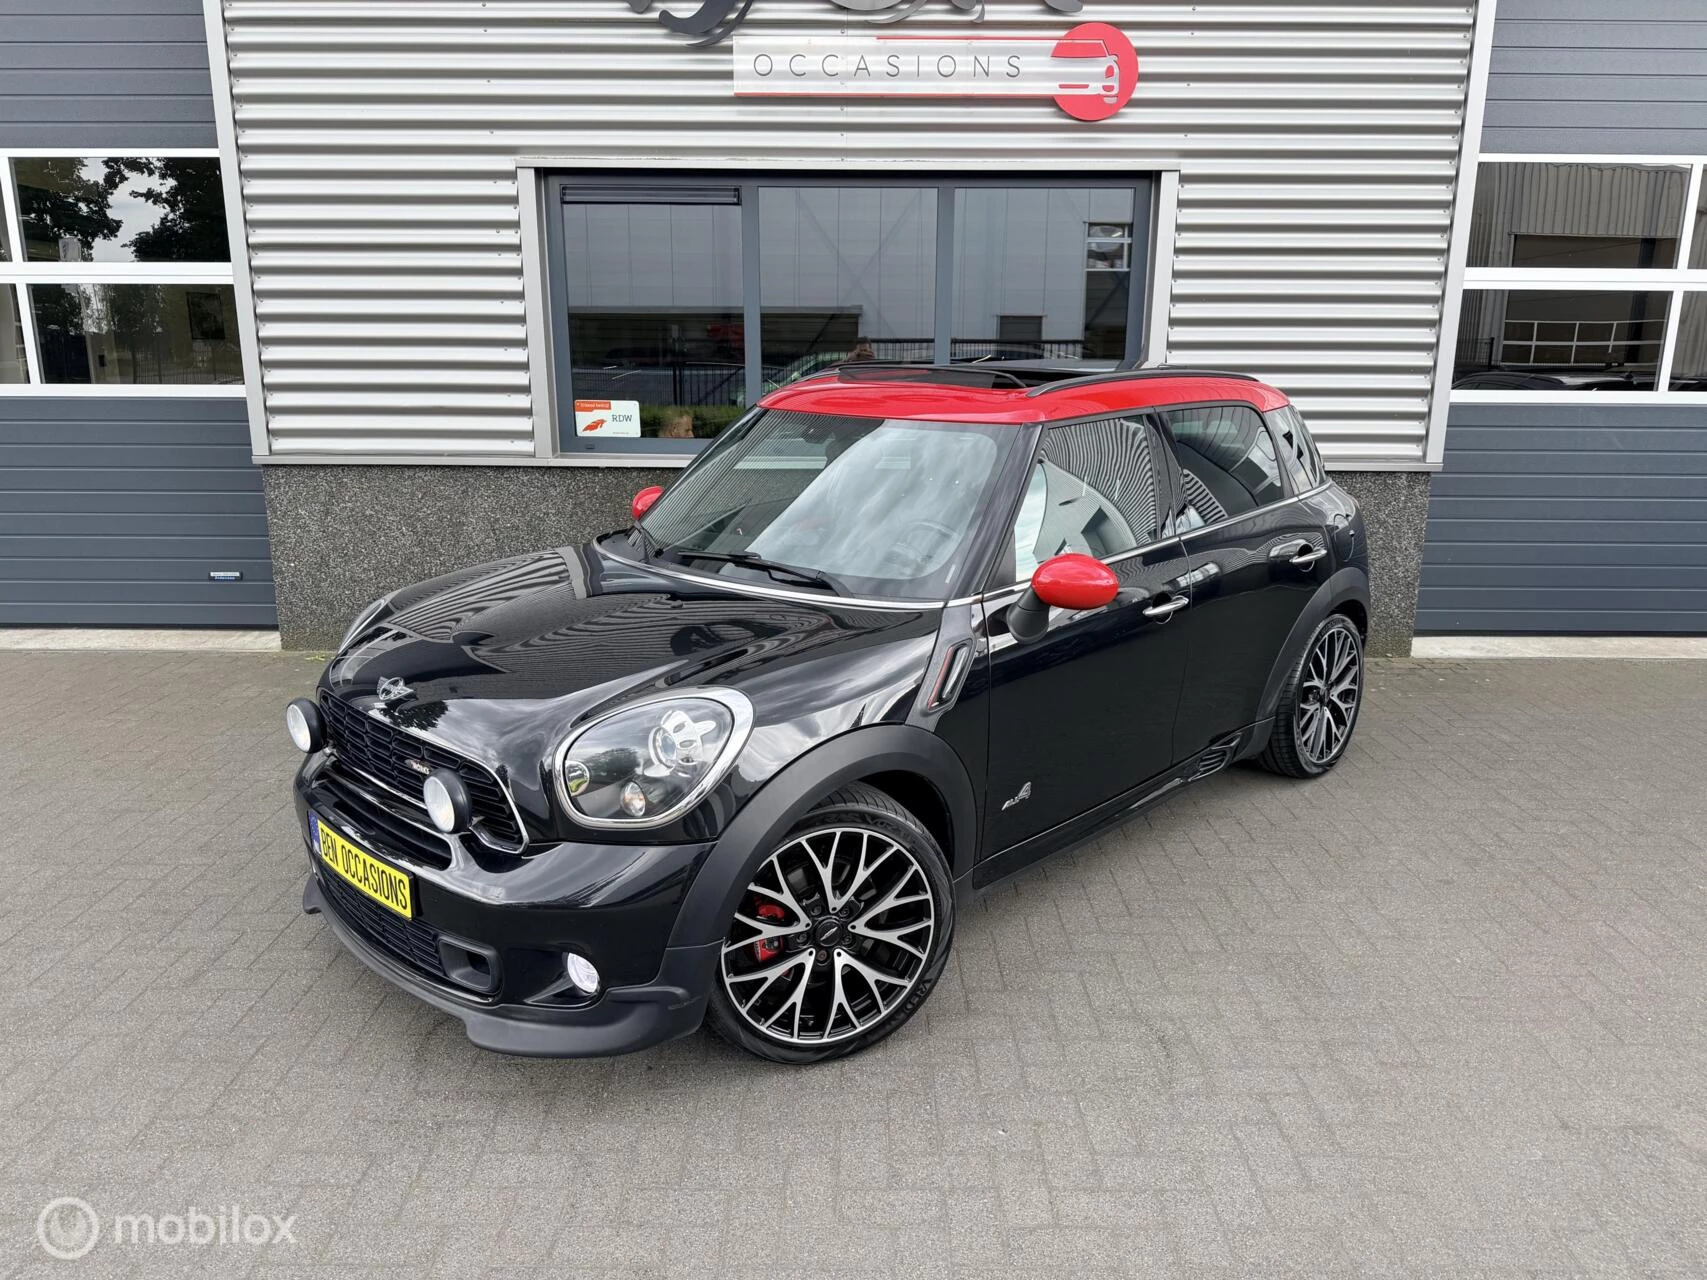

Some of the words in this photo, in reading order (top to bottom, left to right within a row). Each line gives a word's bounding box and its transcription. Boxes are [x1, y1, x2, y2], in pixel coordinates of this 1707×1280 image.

[753, 53, 1021, 78] OCCASIONS
[611, 414, 633, 422] RDW
[320, 827, 339, 867] BEN
[341, 843, 408, 910] OCCASIONS
